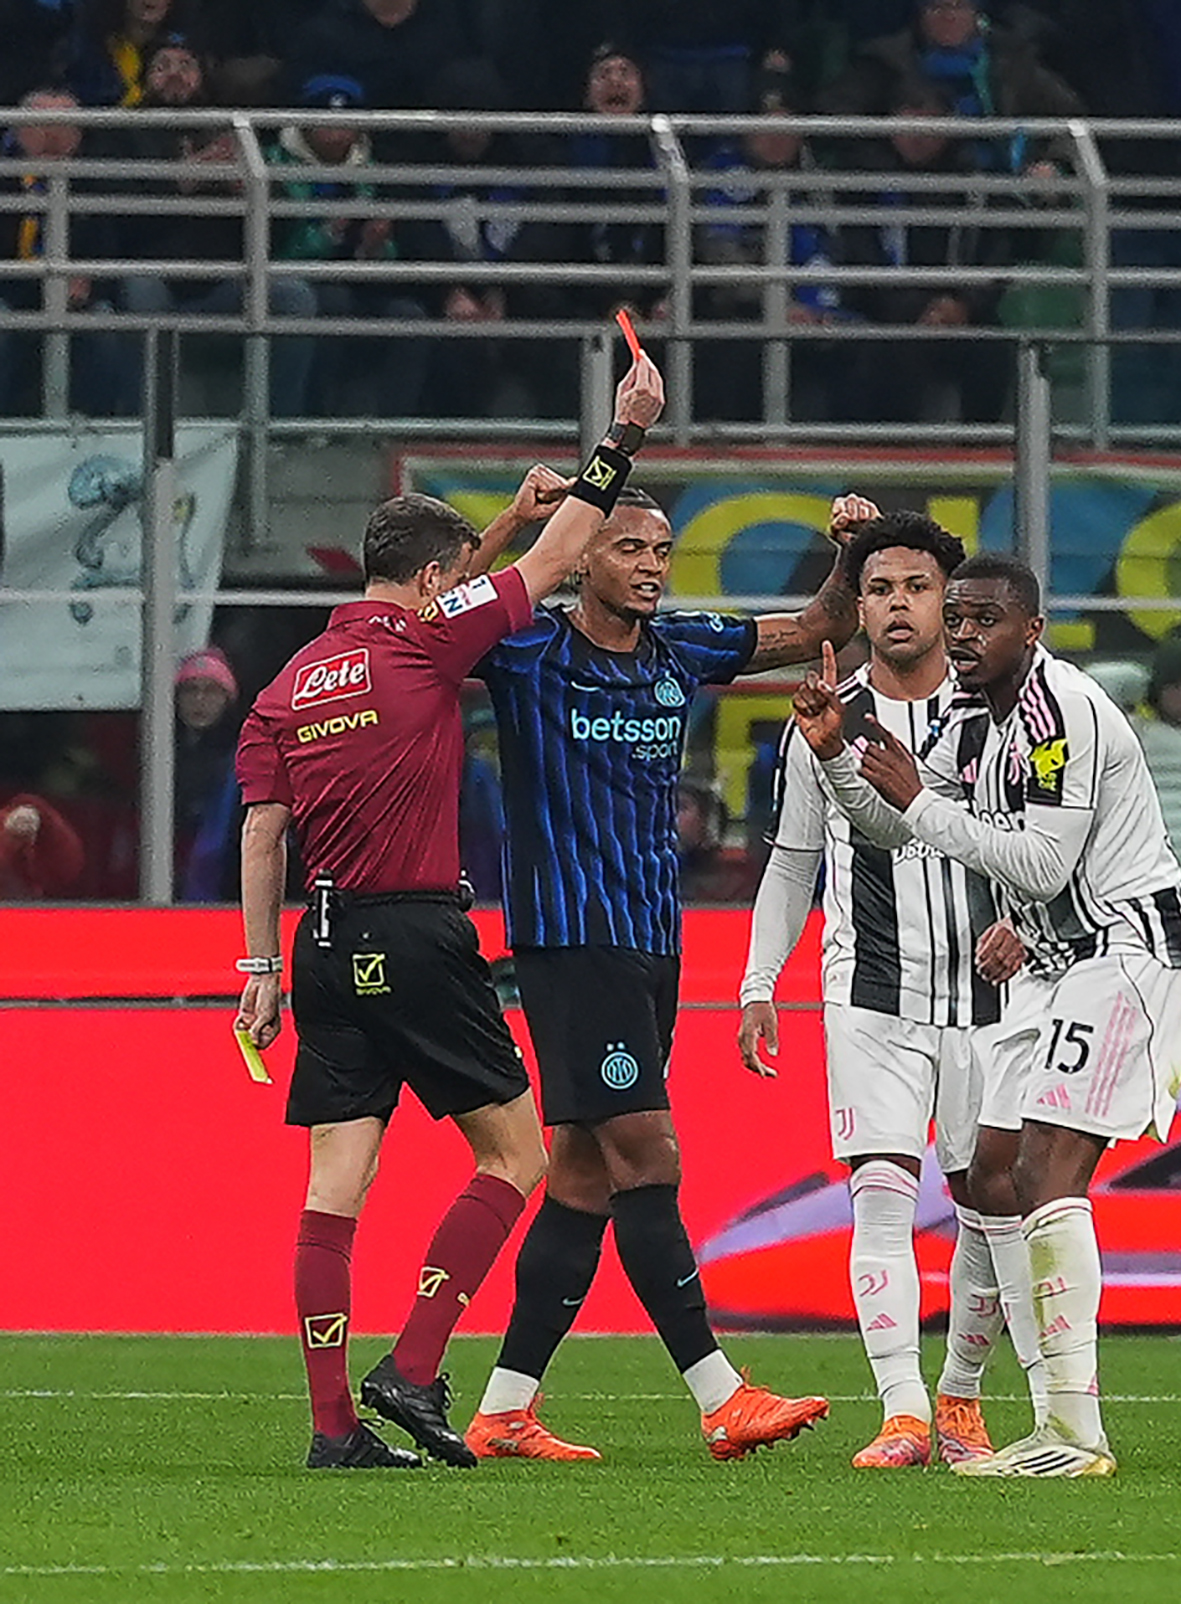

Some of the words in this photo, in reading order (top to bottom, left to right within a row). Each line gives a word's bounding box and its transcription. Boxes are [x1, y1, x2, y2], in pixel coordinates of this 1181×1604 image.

[293, 660, 366, 699] Lete
[297, 710, 378, 743] GIVOVA
[571, 708, 682, 742] betsson
[1044, 1018, 1094, 1075] 15
